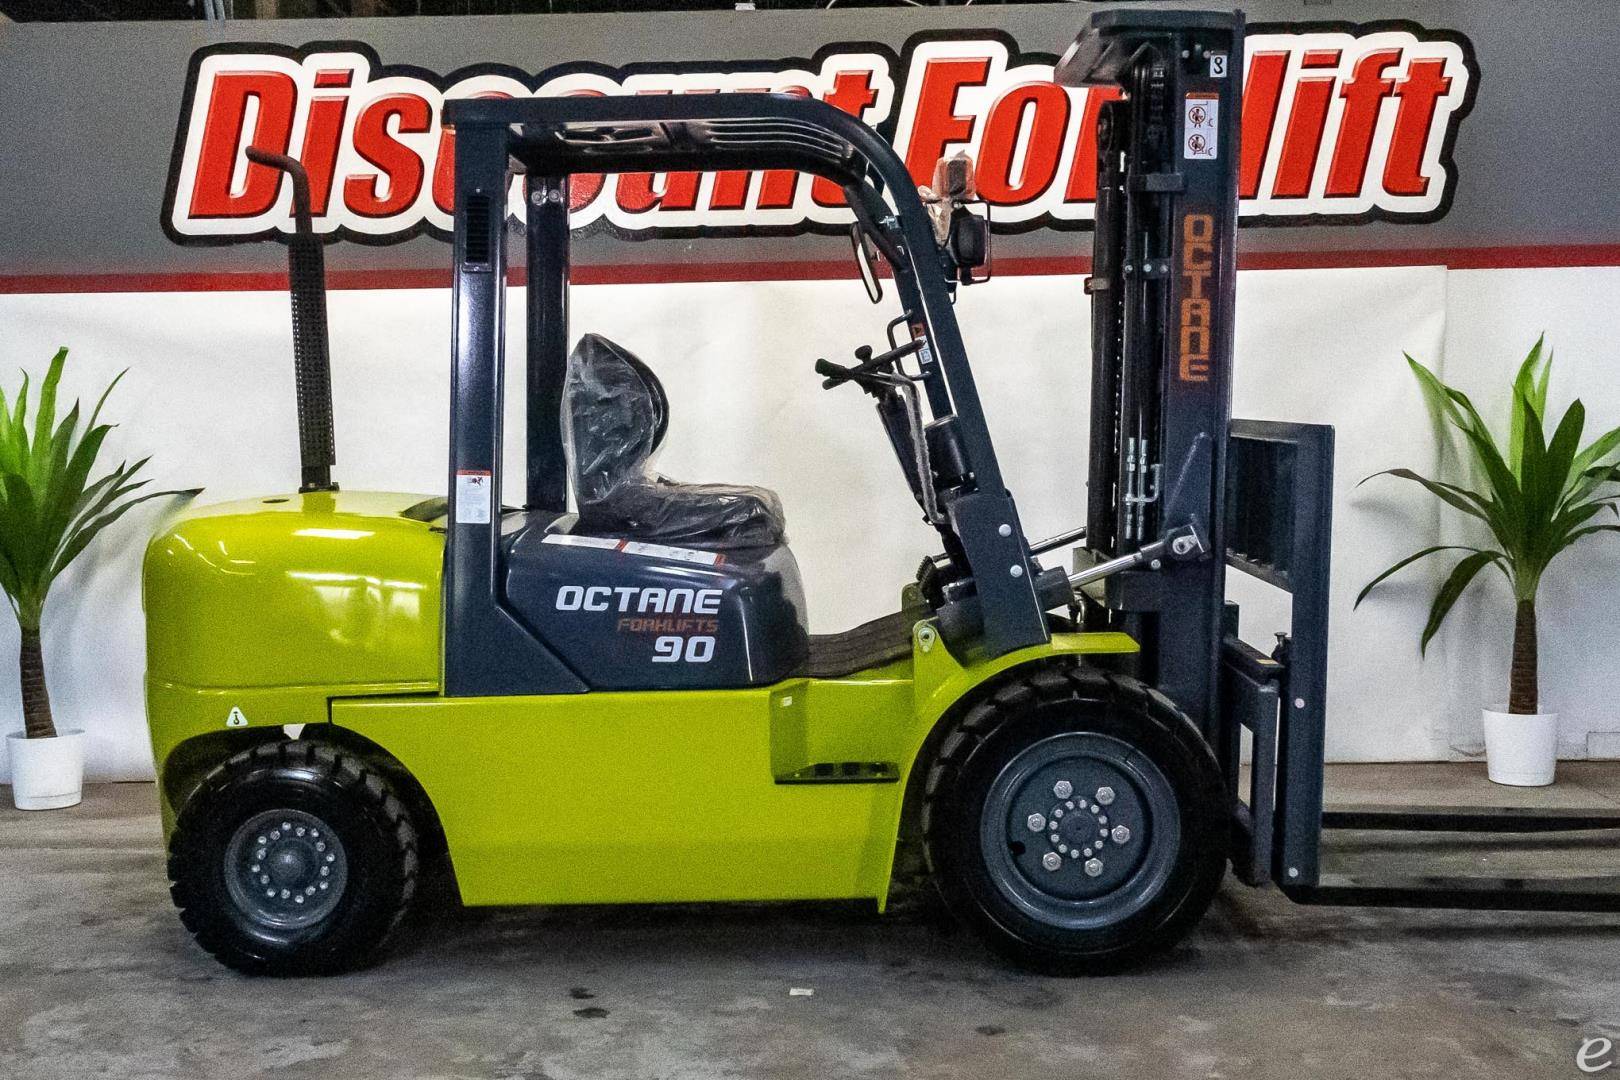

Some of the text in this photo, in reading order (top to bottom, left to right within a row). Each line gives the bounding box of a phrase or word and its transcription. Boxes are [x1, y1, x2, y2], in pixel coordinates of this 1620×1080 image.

[904, 47, 1453, 205] Forlift
[1179, 213, 1214, 382] OCTANE
[555, 585, 723, 615] OCTANE
[616, 617, 720, 633] FORKLIFTS
[651, 635, 716, 663] 90
